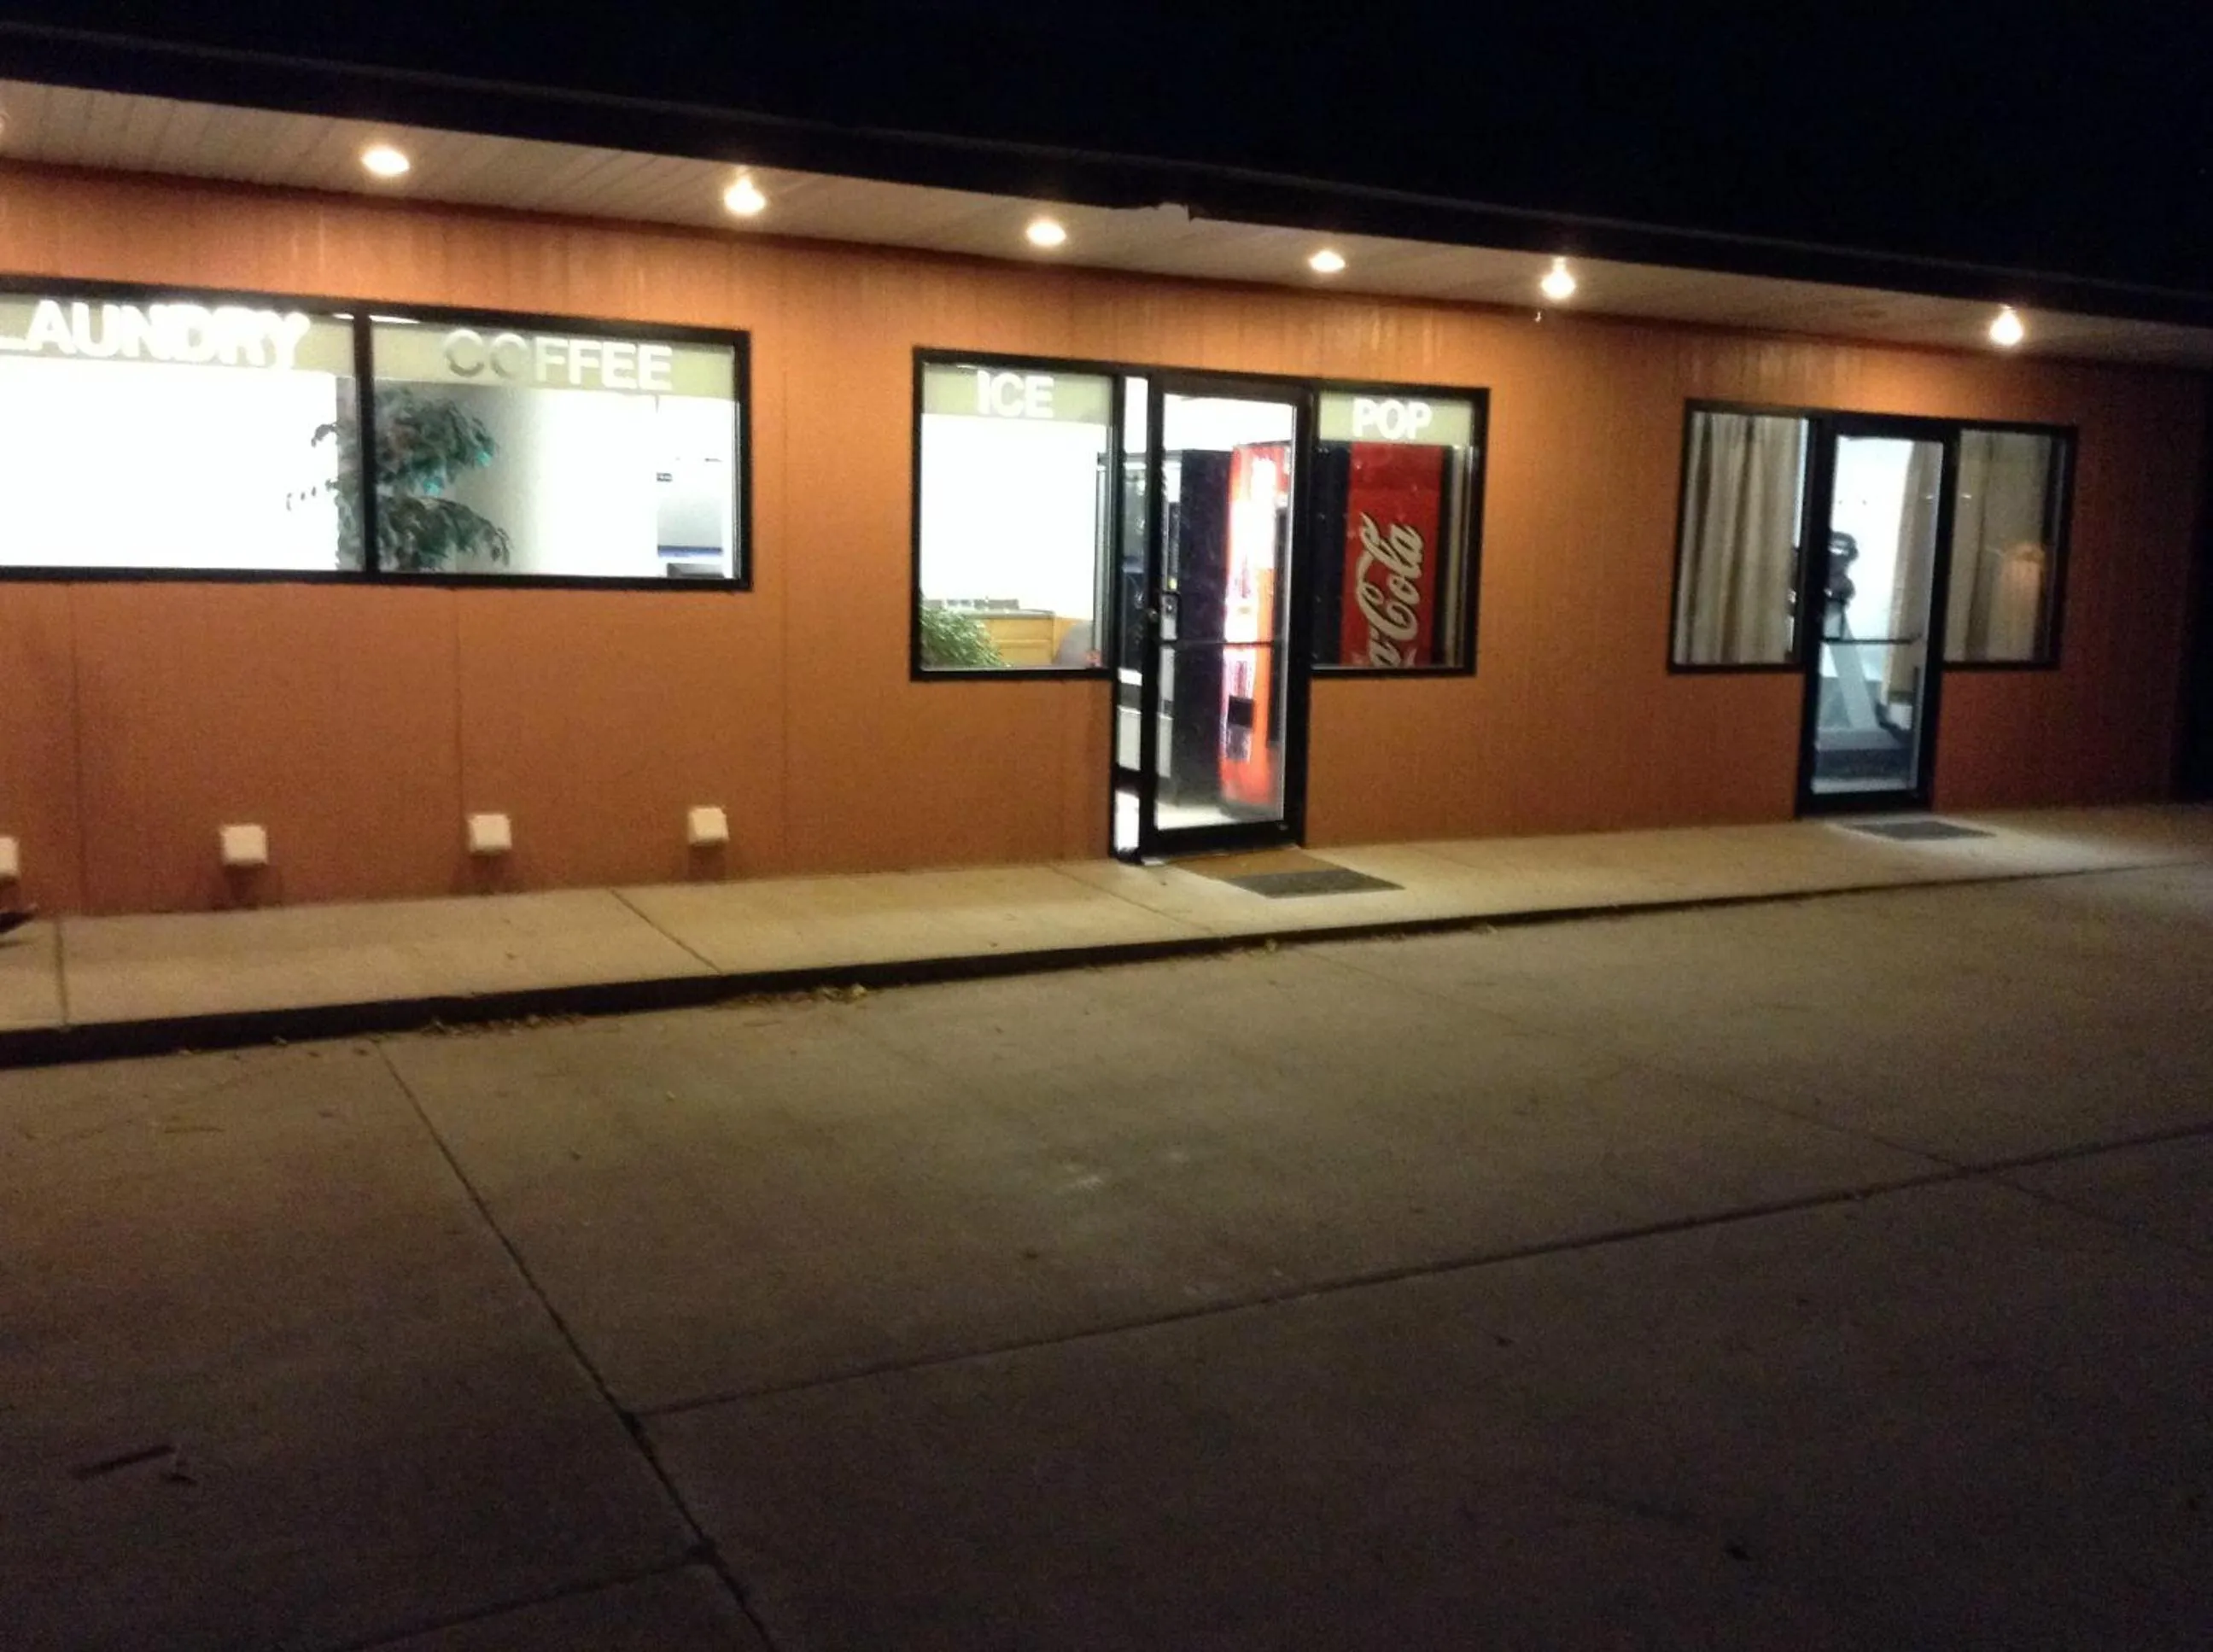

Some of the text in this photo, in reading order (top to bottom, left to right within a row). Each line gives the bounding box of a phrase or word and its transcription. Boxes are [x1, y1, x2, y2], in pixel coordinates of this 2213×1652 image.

[444, 328, 673, 391] COFFEE
[977, 370, 1054, 418] ICE
[1352, 398, 1433, 441] POP
